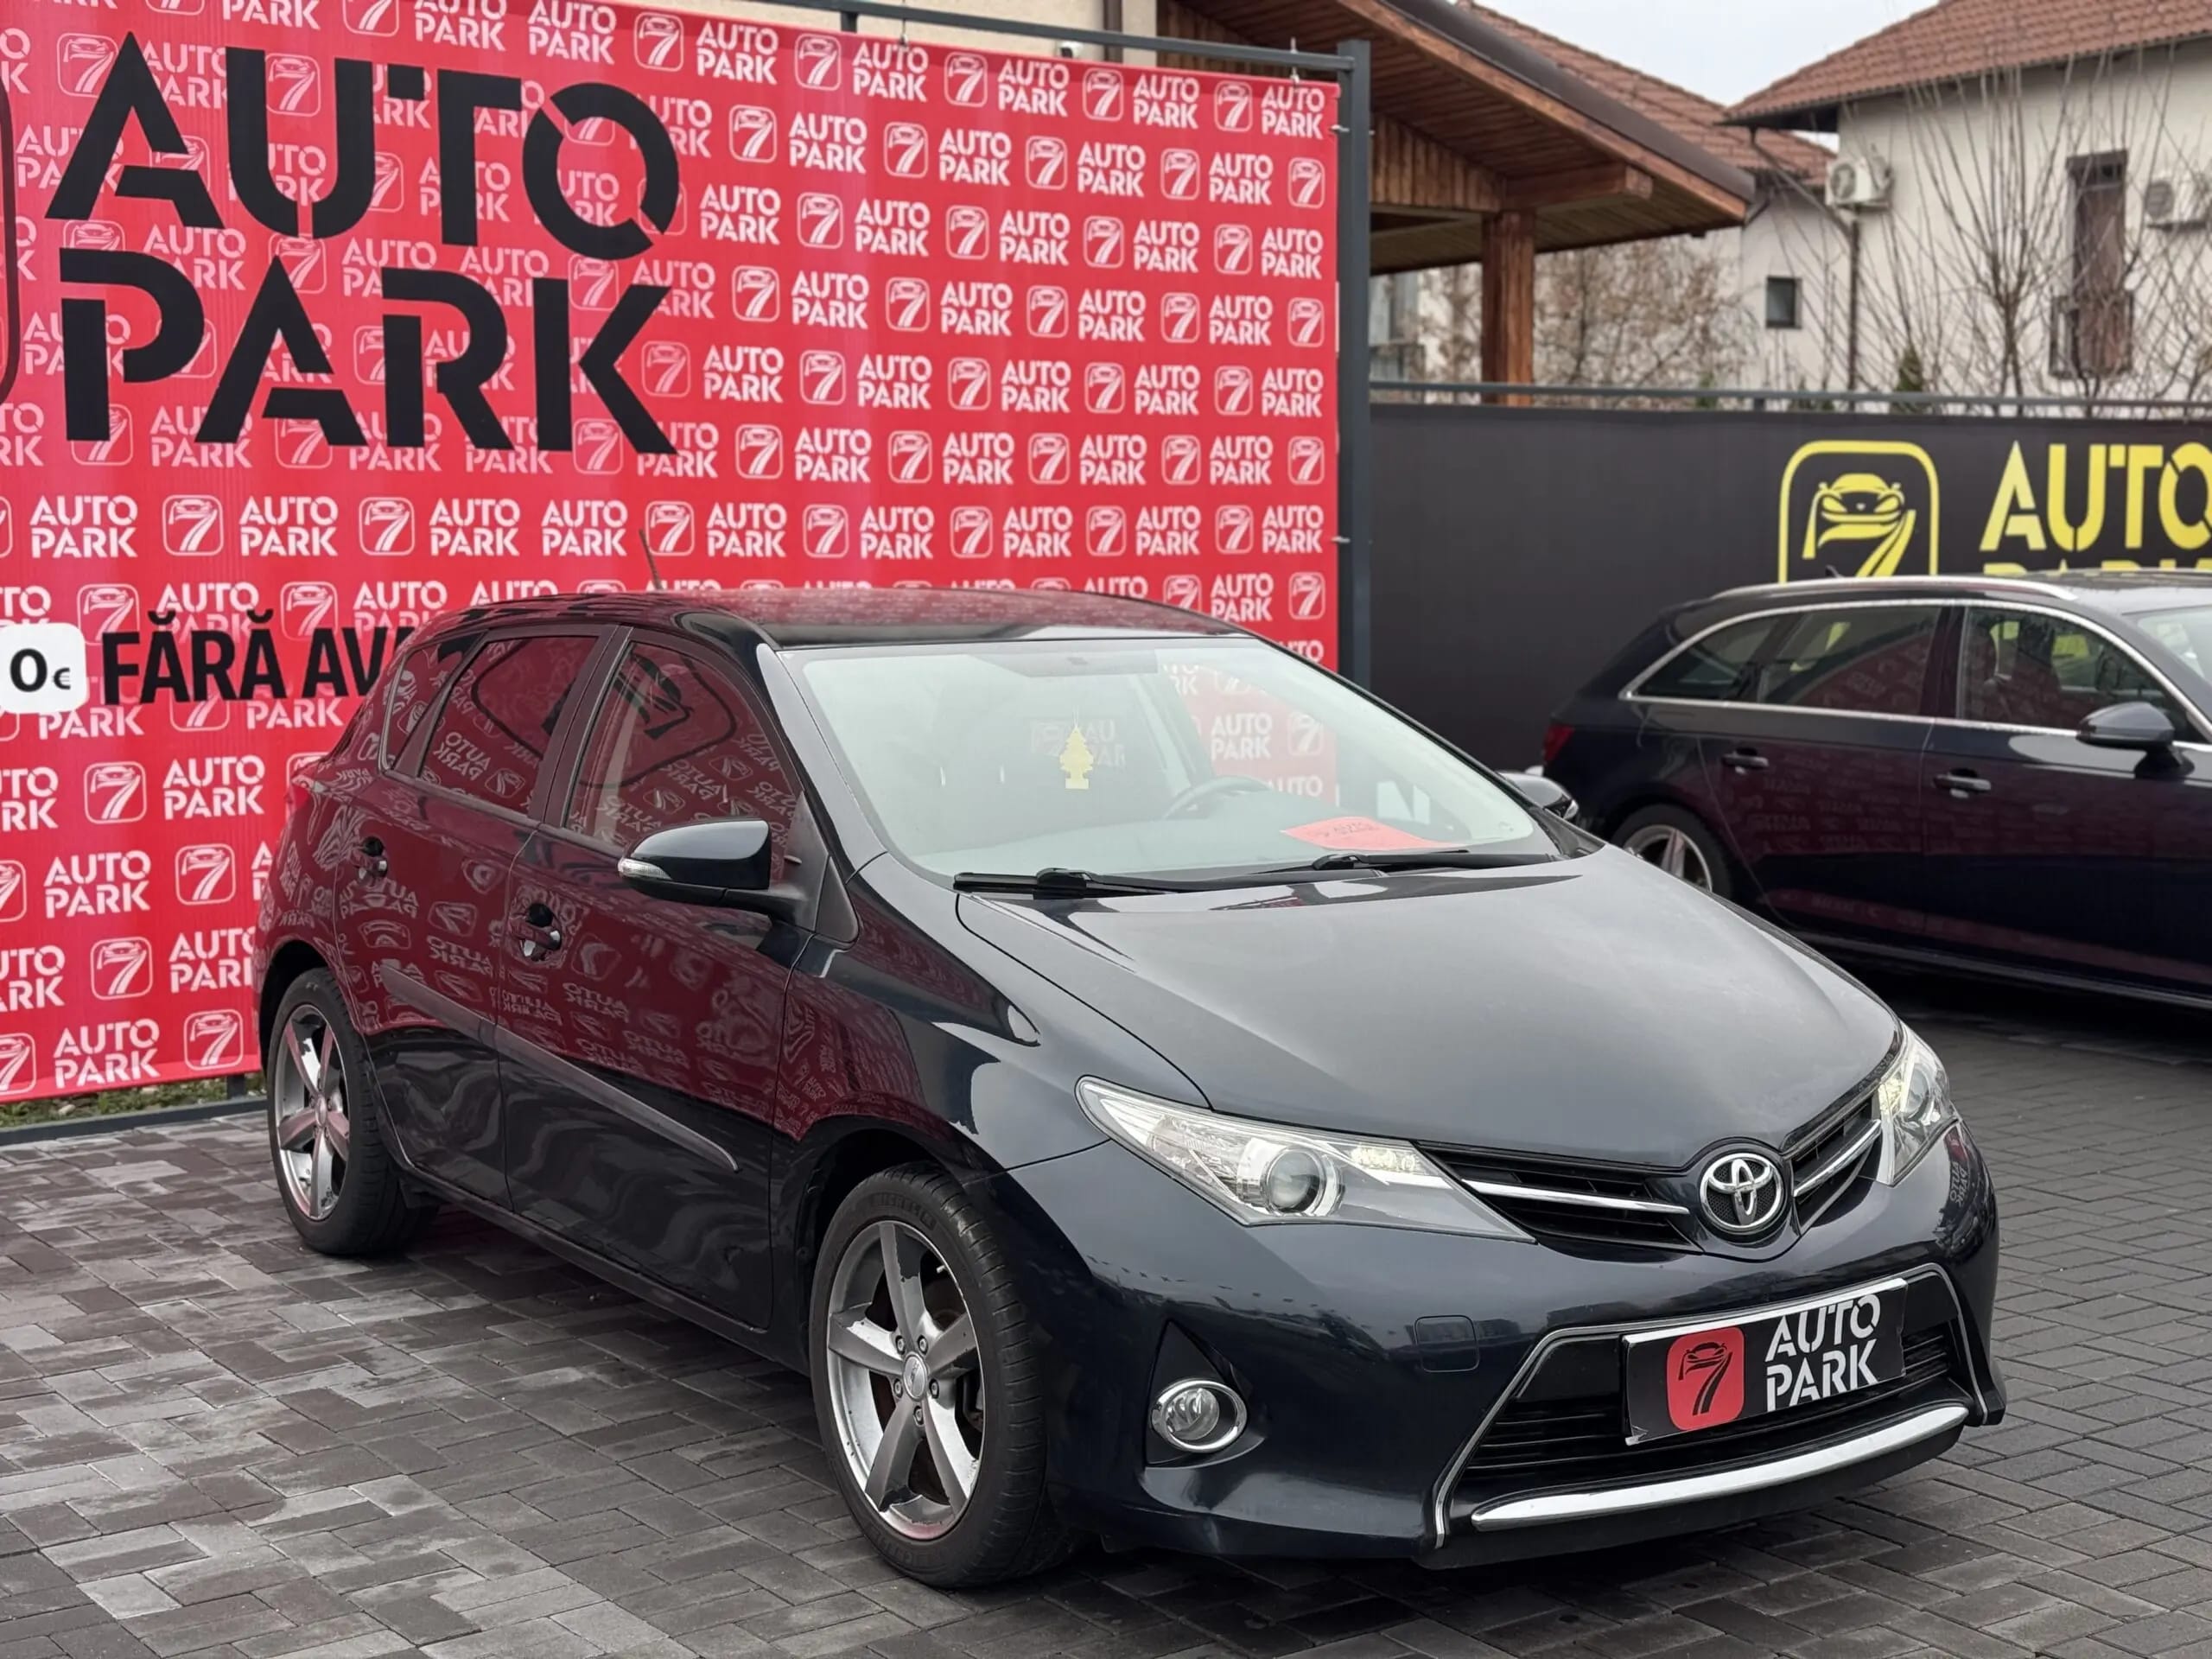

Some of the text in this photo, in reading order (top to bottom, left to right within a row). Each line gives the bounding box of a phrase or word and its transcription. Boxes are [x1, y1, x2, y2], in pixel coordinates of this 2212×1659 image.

[416, 13, 507, 52] PARK
[527, 0, 616, 35] AUTO
[529, 25, 614, 65] PARK
[696, 22, 779, 55] AUTO
[697, 48, 777, 85] PARK
[853, 42, 928, 74] AUTO
[853, 67, 927, 102] PARK
[998, 60, 1069, 90] AUTO
[1133, 74, 1199, 104] AUTO
[998, 83, 1067, 117] PARK
[1133, 98, 1198, 129] PARK
[1262, 86, 1325, 113] AUTO
[789, 112, 868, 145] AUTO
[1262, 108, 1323, 139] PARK
[45, 31, 680, 262] AUTO
[790, 139, 866, 174] PARK
[939, 129, 1012, 159] AUTO
[1077, 142, 1146, 171] AUTO
[939, 154, 1010, 186] PARK
[1077, 166, 1144, 197] PARK
[1209, 153, 1274, 180] AUTO
[700, 184, 781, 217] AUTO
[1209, 176, 1271, 205] PARK
[701, 211, 779, 245] PARK
[855, 199, 931, 230] AUTO
[999, 210, 1071, 239] AUTO
[143, 223, 247, 258] AUTO
[855, 224, 928, 257] PARK
[1134, 220, 1200, 248] AUTO
[1261, 227, 1324, 255] AUTO
[341, 237, 438, 270] AUTO
[459, 246, 550, 278] AUTO
[1000, 235, 1069, 265] PARK
[1134, 245, 1198, 273] PARK
[1262, 251, 1321, 279] PARK
[632, 258, 716, 290] AUTO
[791, 270, 869, 302] AUTO
[940, 282, 1013, 310] AUTO
[1077, 289, 1146, 316] AUTO
[1209, 295, 1273, 321] AUTO
[792, 297, 868, 329] PARK
[941, 307, 1011, 336] PARK
[1078, 314, 1144, 341] PARK
[1209, 319, 1271, 346] PARK
[59, 247, 680, 456] PARK
[703, 346, 784, 375] AUTO
[857, 354, 932, 383] AUTO
[1001, 360, 1071, 387] AUTO
[1135, 365, 1200, 389] AUTO
[1262, 368, 1324, 393] AUTO
[704, 372, 783, 403] PARK
[857, 379, 931, 410] PARK
[1001, 385, 1070, 413] PARK
[1135, 390, 1198, 415] PARK
[1262, 391, 1322, 417] PARK
[151, 435, 253, 468] PARK
[795, 428, 871, 454] AUTO
[944, 432, 1014, 457] AUTO
[1079, 435, 1147, 460] AUTO
[1210, 435, 1274, 461] AUTO
[349, 442, 442, 472] PARK
[466, 443, 554, 474] PARK
[638, 449, 719, 478] PARK
[796, 454, 870, 483] PARK
[944, 459, 1013, 484] PARK
[1080, 458, 1146, 485] PARK
[1210, 460, 1271, 485] PARK
[29, 495, 138, 526] AUTO
[239, 496, 339, 526] AUTO
[1980, 441, 2212, 552] AUTO
[429, 499, 520, 527] AUTO
[541, 499, 628, 528] AUTO
[707, 503, 787, 531] AUTO
[860, 506, 934, 533] AUTO
[1003, 506, 1073, 532] AUTO
[1135, 505, 1201, 531] AUTO
[1262, 505, 1324, 530] AUTO
[31, 527, 137, 558] PARK
[240, 526, 338, 556] PARK
[430, 527, 519, 556] PARK
[542, 527, 626, 556] PARK
[708, 530, 785, 557] PARK
[861, 531, 932, 559] PARK
[1003, 531, 1071, 557] PARK
[1136, 530, 1199, 556] PARK
[1262, 528, 1322, 553] PARK
[156, 581, 260, 613] AUTO
[353, 580, 448, 610] AUTO
[1211, 573, 1274, 599] AUTO
[1211, 597, 1272, 621] PARK
[101, 608, 415, 705] FĂRĂ AV
[39, 706, 144, 740] PARK
[246, 698, 343, 730] PARK
[1211, 712, 1274, 735] AUTO
[1211, 735, 1274, 761] PARK
[162, 754, 265, 789] AUTO
[164, 785, 264, 820] PARK
[43, 850, 151, 887] AUTO
[45, 880, 150, 918] PARK
[54, 1019, 160, 1058] AUTO
[54, 1048, 161, 1090] PARK
[1764, 1293, 1882, 1363] AUTO
[1765, 1338, 1880, 1413] PARK
